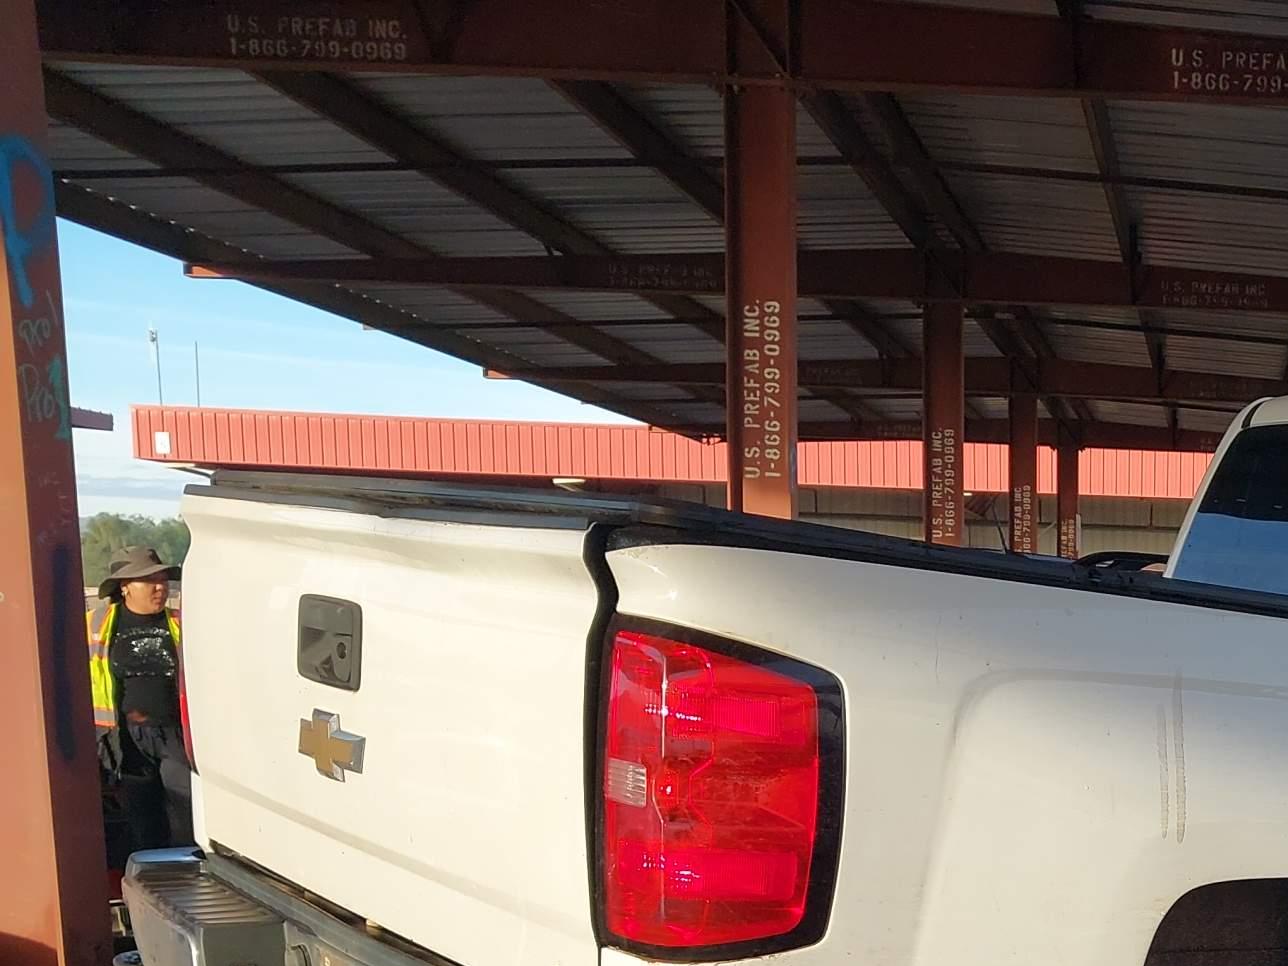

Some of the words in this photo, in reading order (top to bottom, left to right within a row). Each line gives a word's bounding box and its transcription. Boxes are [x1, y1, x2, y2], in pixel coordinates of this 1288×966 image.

[278, 17, 357, 38] PREFAB
[368, 19, 408, 40] INC.
[743, 299, 761, 338] INC.
[743, 348, 761, 428] PREFAB
[763, 300, 781, 478] 1-866-799-0969
[744, 440, 761, 478] U.S.
[931, 457, 943, 508] PREFAB
